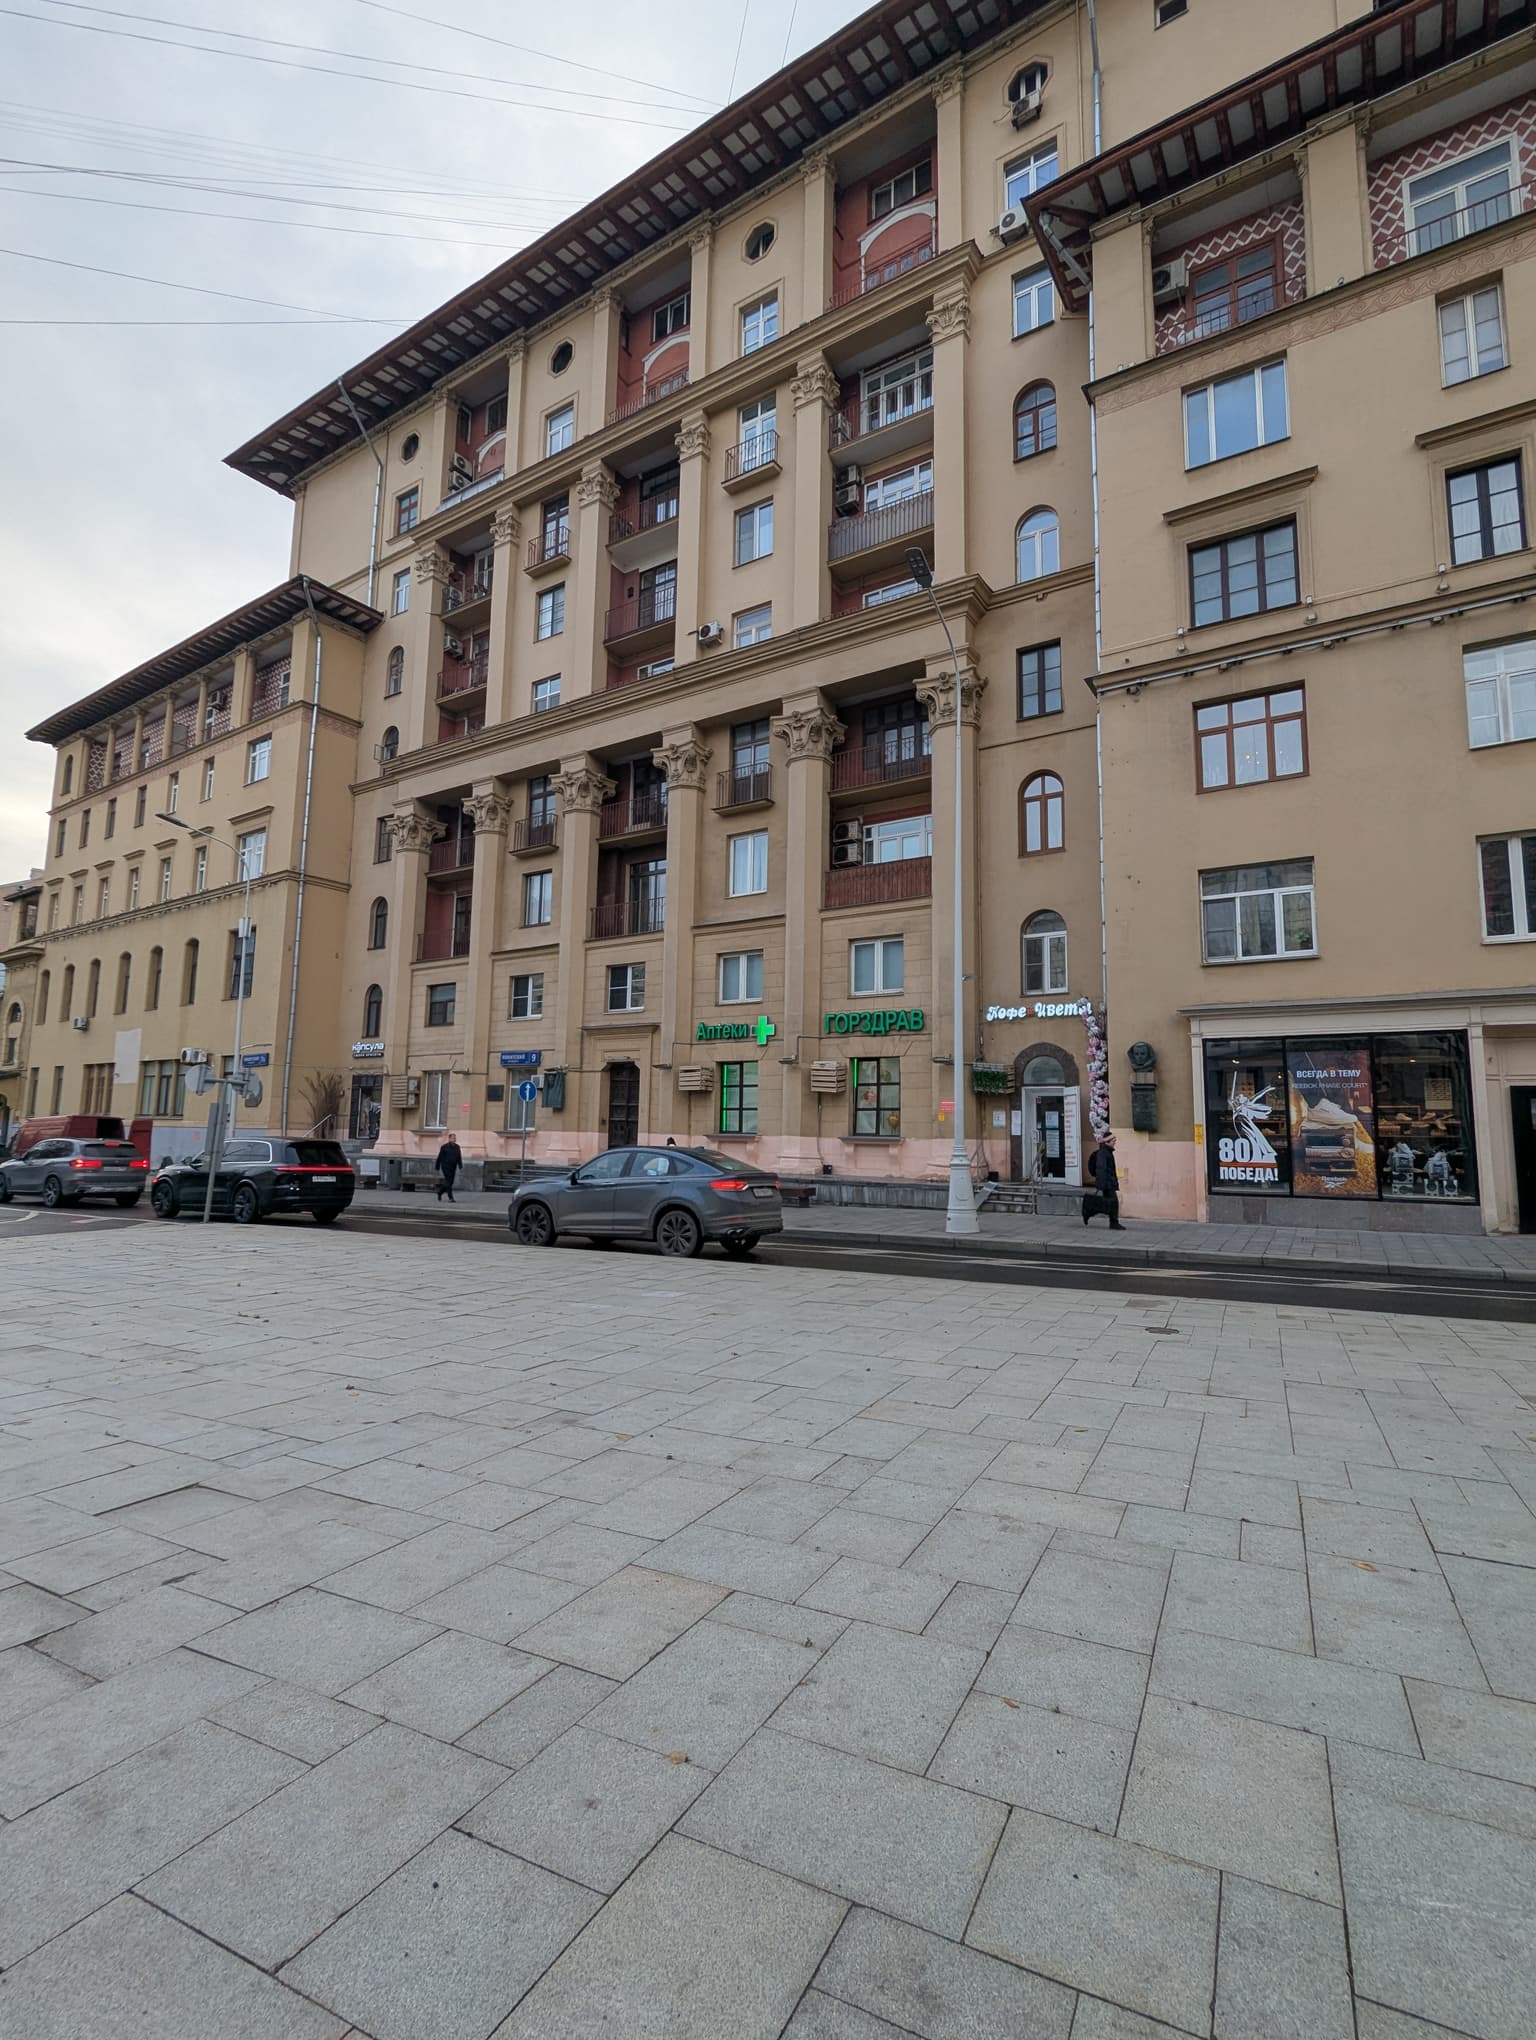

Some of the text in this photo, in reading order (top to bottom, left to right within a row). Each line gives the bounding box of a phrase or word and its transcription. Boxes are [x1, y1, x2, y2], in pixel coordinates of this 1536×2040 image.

[986, 1006, 1027, 1021] Кофе
[1034, 1001, 1093, 1018] Цветы
[696, 1021, 749, 1041] Аптеки
[824, 1009, 924, 1036] ГОРЗДРАВ
[531, 1053, 537, 1063] 9
[1296, 1069, 1361, 1079] ВСЕГДА В ТЕМУ
[1218, 1137, 1250, 1163] 80
[1219, 1166, 1280, 1182] ПОБЕДА!
